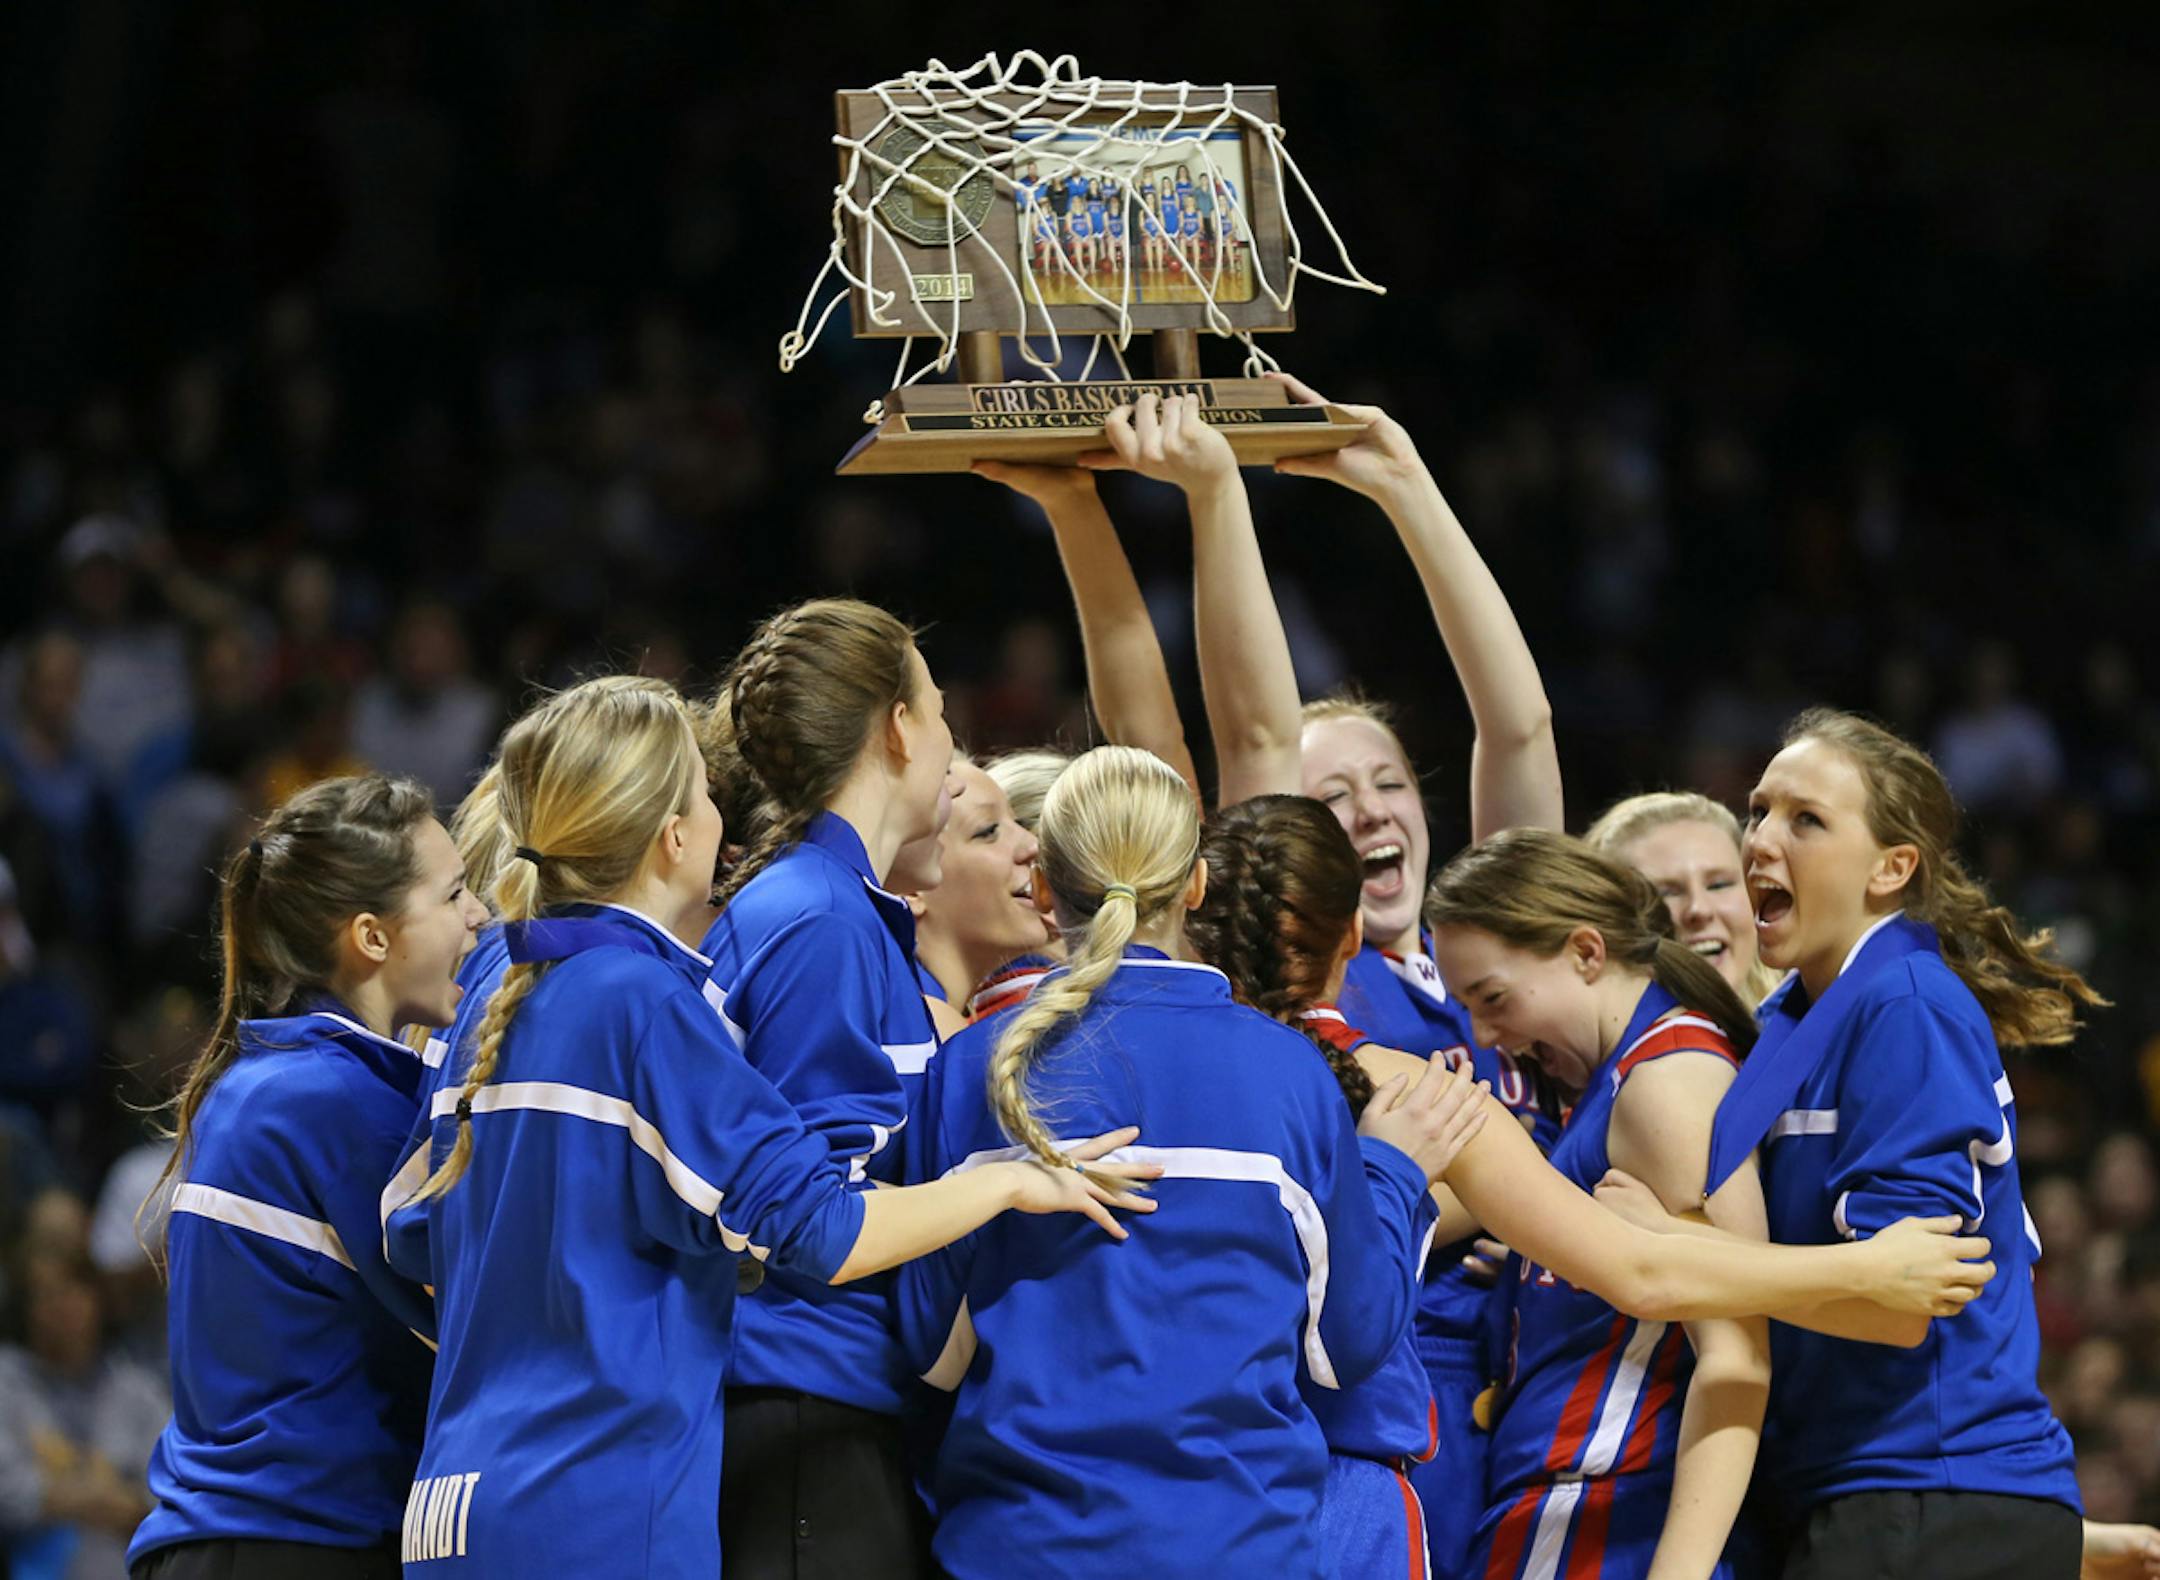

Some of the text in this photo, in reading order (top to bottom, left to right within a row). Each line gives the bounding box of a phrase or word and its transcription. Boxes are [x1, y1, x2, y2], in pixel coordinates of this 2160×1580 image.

[974, 387, 1051, 413] GIRLS
[969, 414, 1042, 429] STATE
[1044, 413, 1109, 427] CLAS
[1415, 962, 1436, 980] W
